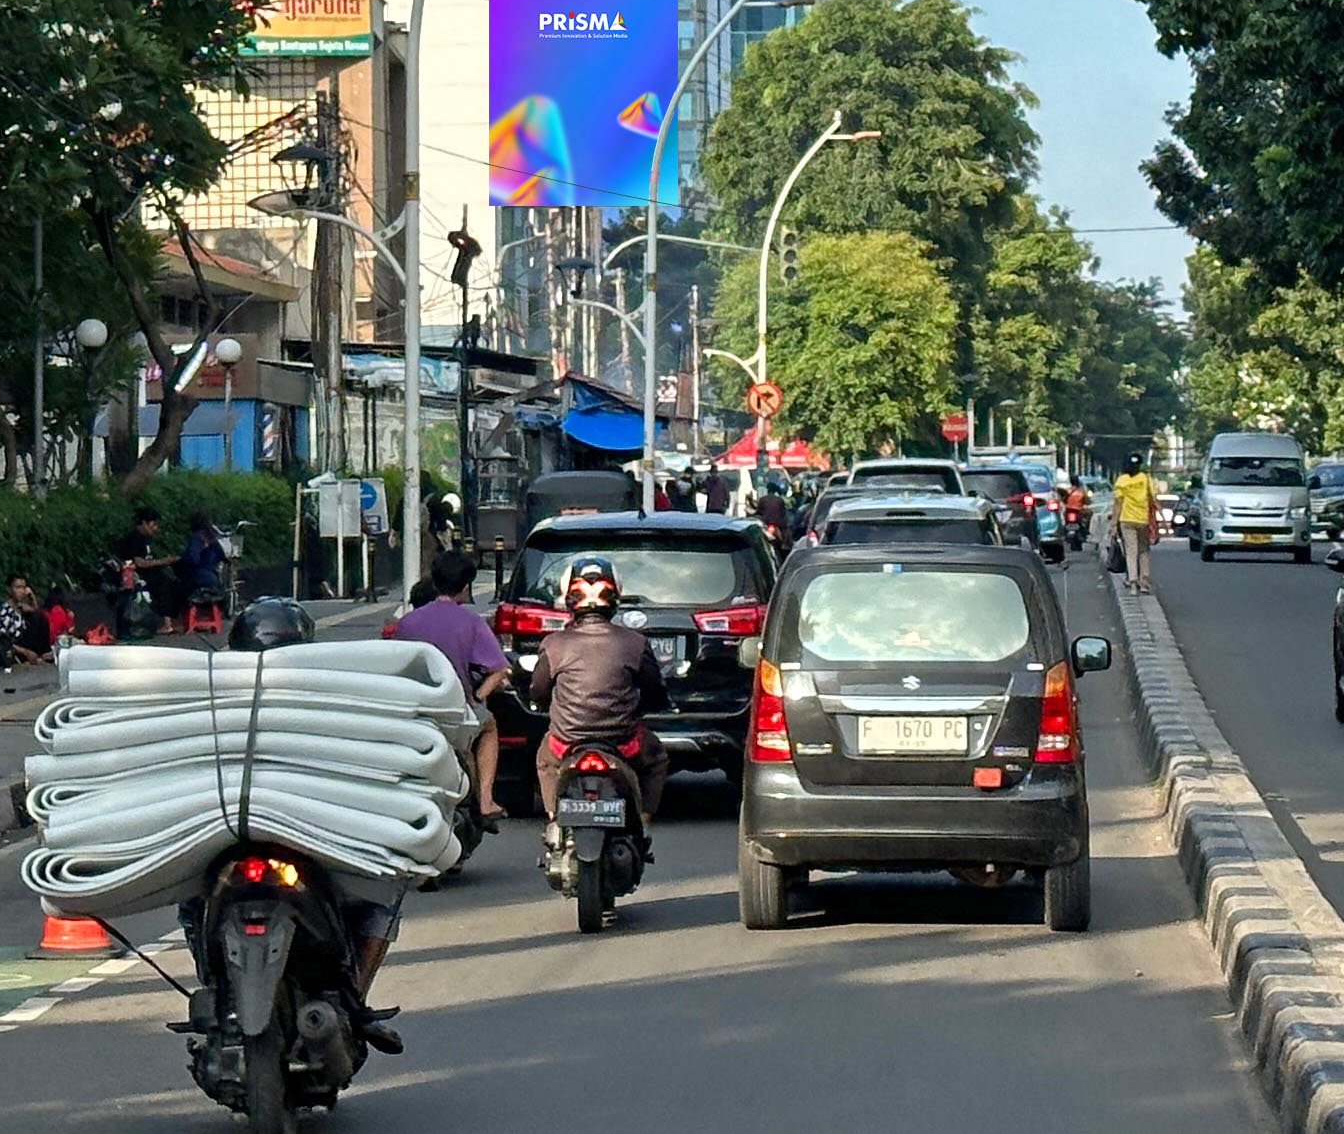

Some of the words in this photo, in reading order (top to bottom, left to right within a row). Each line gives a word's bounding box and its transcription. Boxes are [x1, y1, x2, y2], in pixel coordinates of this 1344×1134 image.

[863, 720, 872, 738] F
[896, 719, 932, 738] 1670
[944, 720, 963, 738] PC
